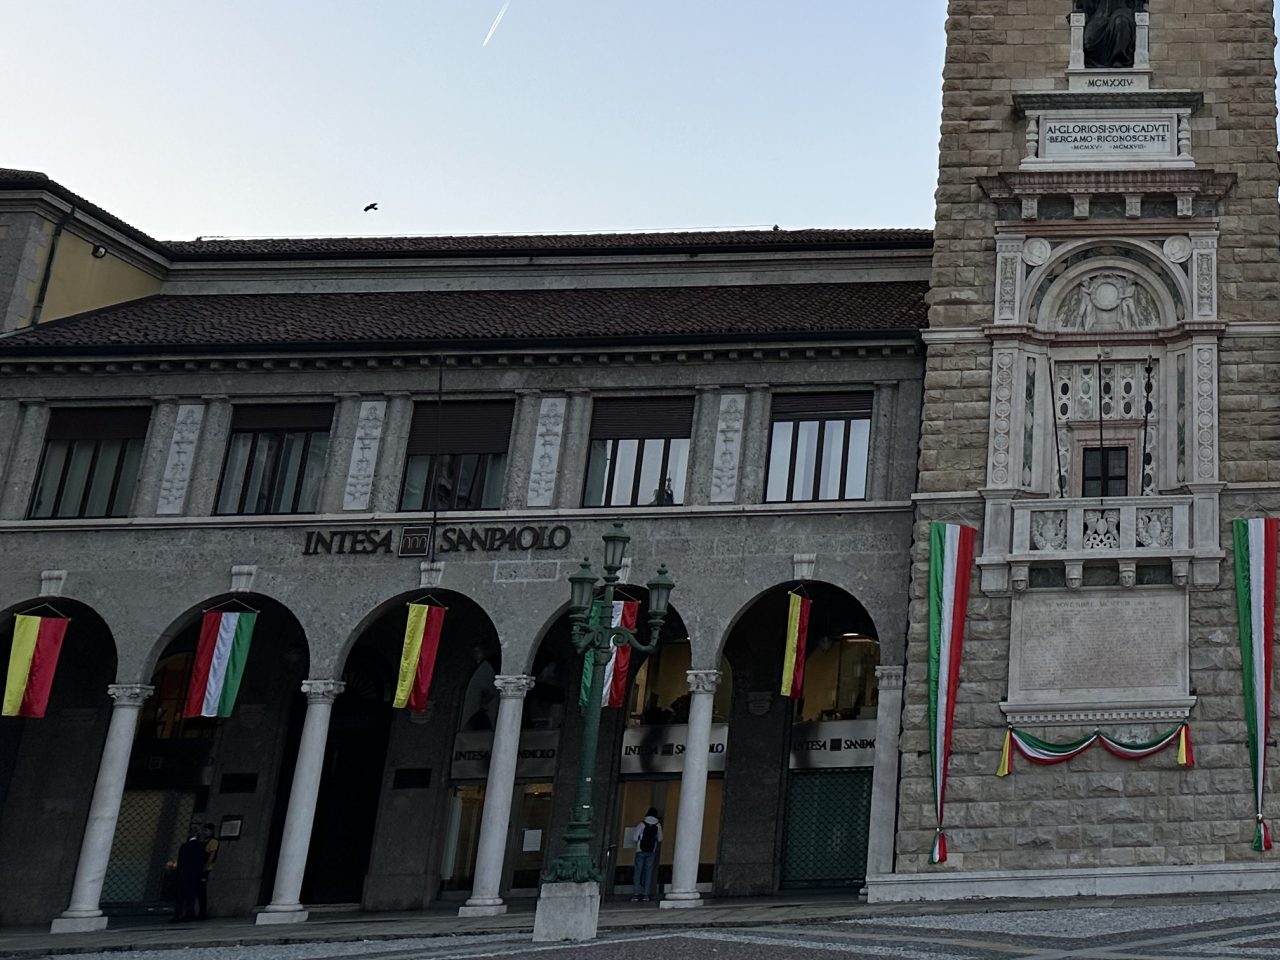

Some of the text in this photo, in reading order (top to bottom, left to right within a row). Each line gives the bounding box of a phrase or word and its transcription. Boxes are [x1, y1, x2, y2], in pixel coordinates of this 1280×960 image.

[1096, 134, 1167, 143] RICONOSCENTE
[302, 525, 572, 555] INTESA SANPAOLO
